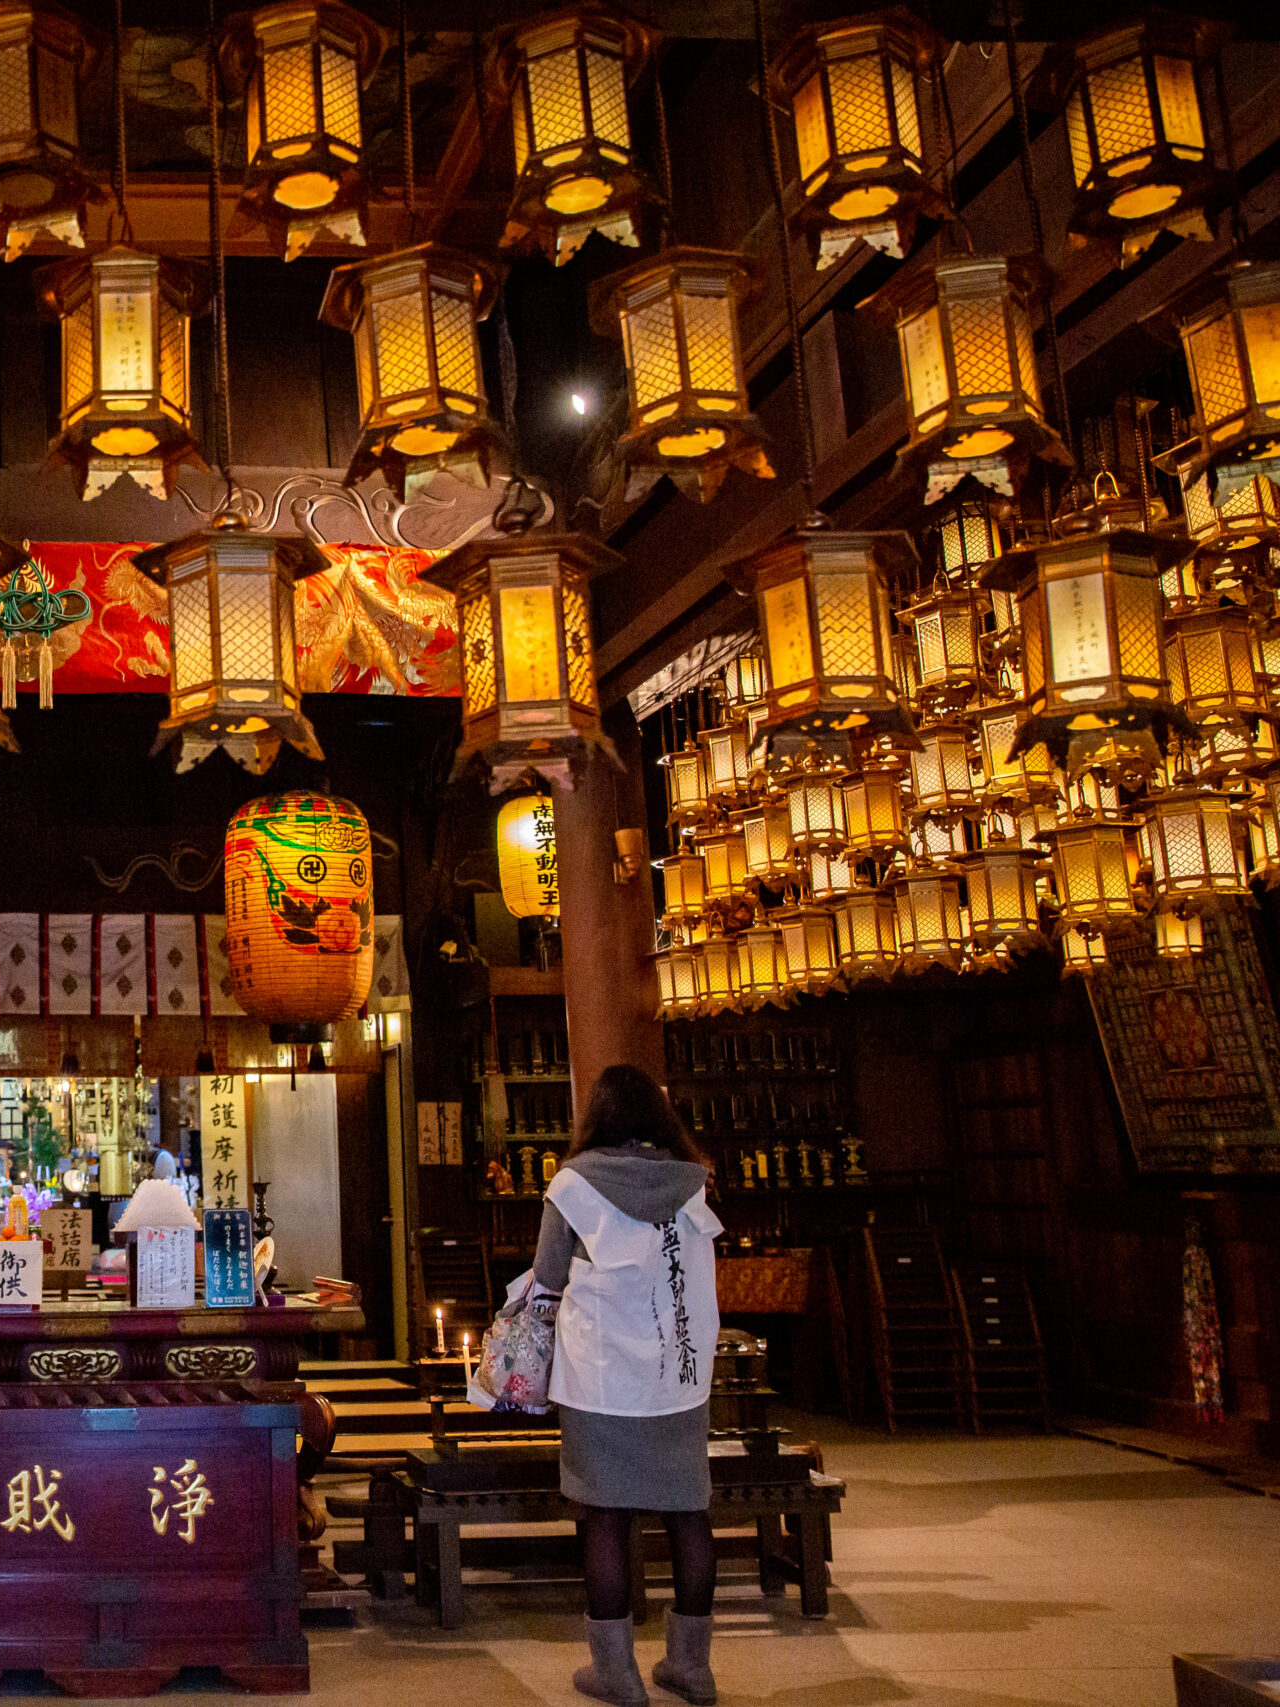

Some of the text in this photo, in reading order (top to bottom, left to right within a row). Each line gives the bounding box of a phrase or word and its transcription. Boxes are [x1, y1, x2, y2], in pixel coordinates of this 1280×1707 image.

[532, 804, 559, 906] 南無不動明王
[60, 1211, 82, 1267] 法話席
